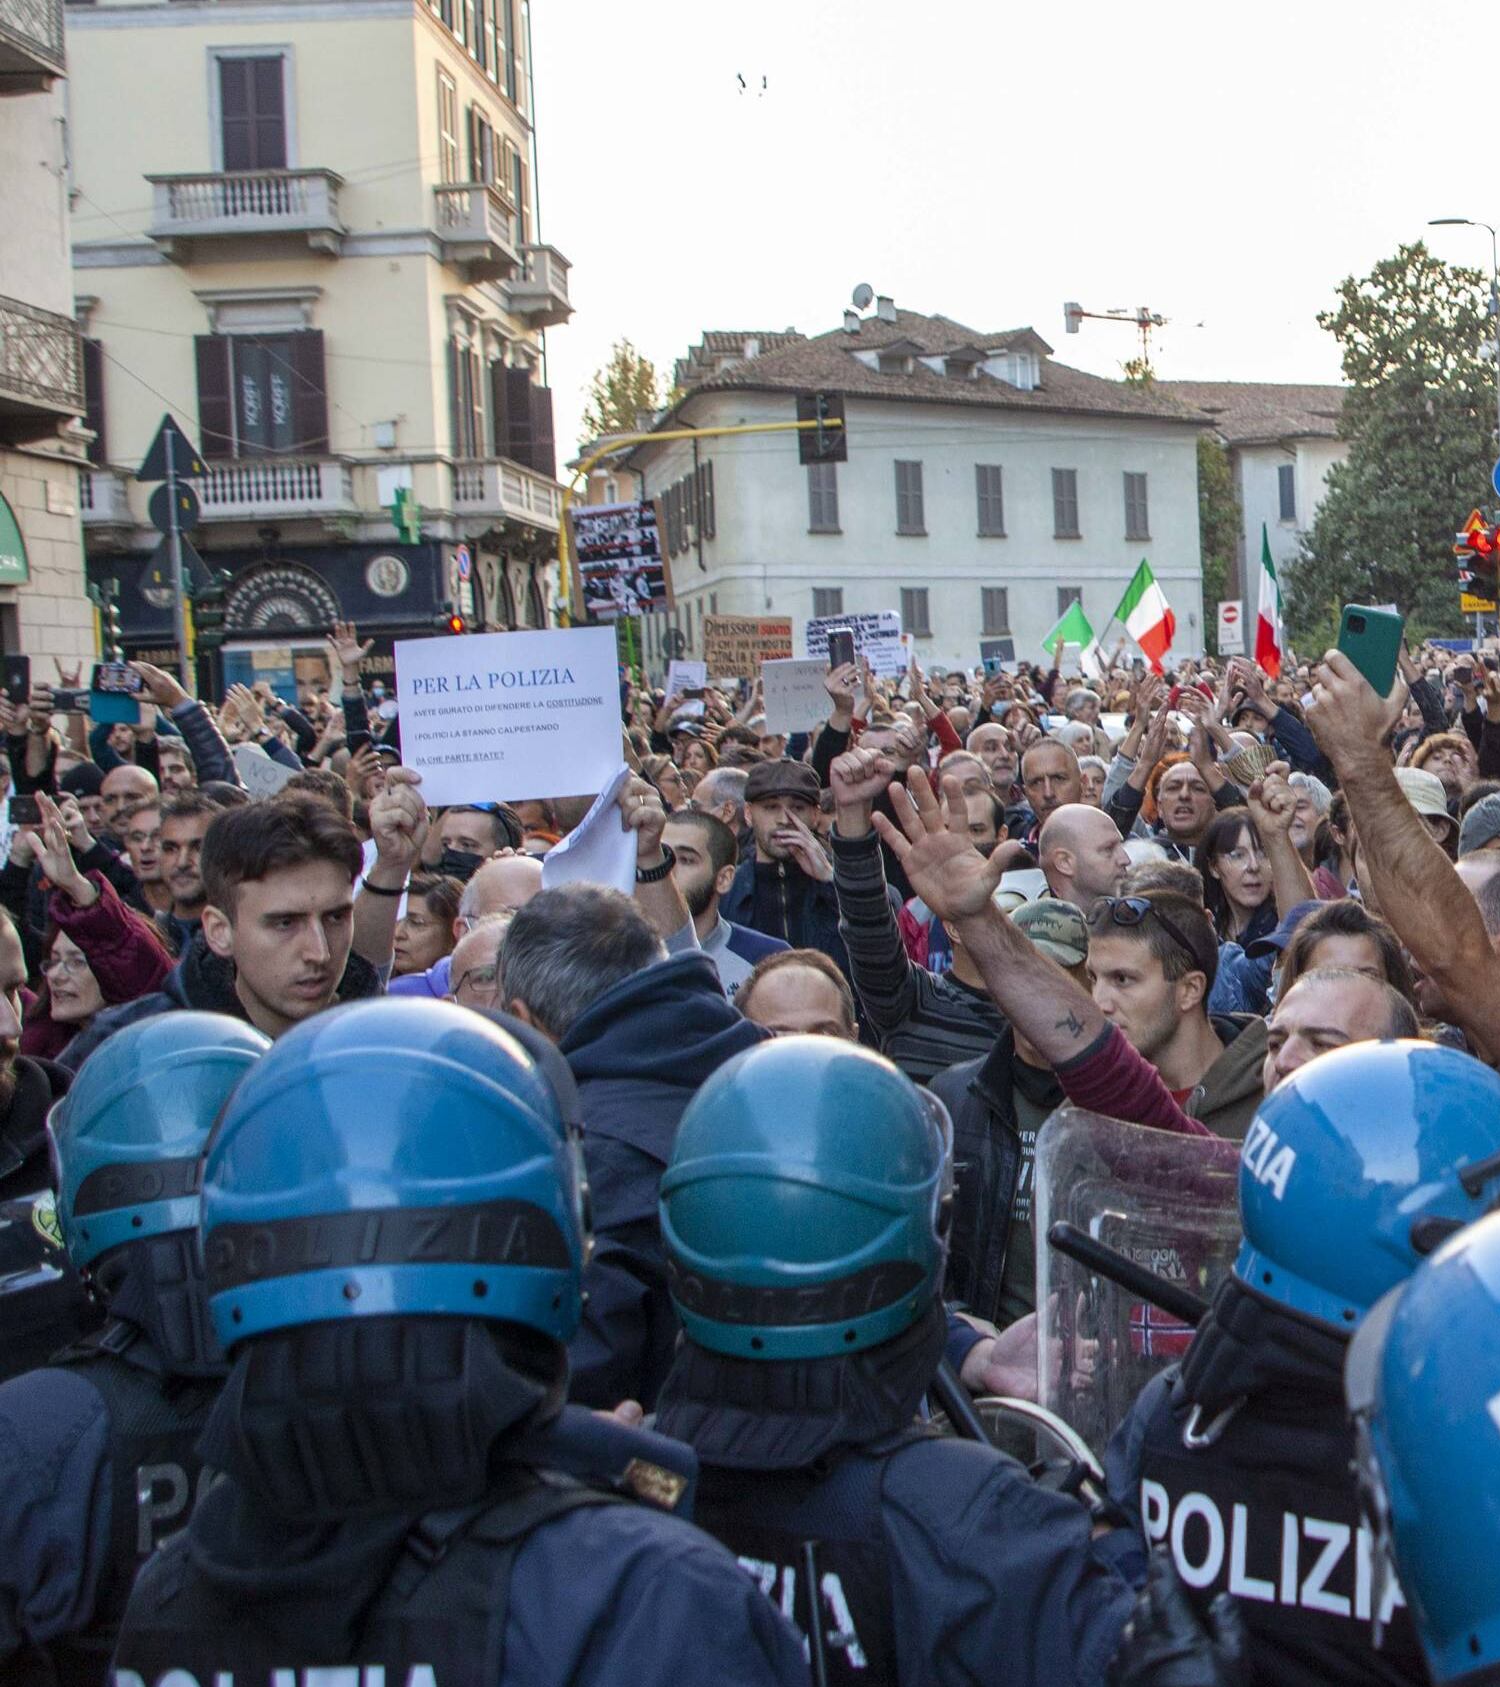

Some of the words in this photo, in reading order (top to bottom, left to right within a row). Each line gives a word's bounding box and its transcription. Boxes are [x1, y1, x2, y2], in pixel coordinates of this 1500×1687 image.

[412, 676, 450, 695] PER
[454, 673, 482, 691] LA
[488, 667, 576, 689] POLIZIA
[413, 708, 437, 717] AVETE
[438, 705, 473, 715] GIURATO
[475, 704, 484, 713] DI
[485, 702, 531, 712] DIFENDERE
[533, 701, 545, 709] LA
[546, 696, 604, 708] COSTITUZIONE
[418, 732, 449, 741] POLITICI
[450, 730, 461, 738] LA
[462, 727, 497, 737] STANNO
[498, 723, 560, 735] CALPESTANDO
[416, 757, 428, 766] DA
[428, 756, 444, 766] CHE
[445, 753, 472, 764] PARTE
[473, 751, 504, 762] STATE?
[215, 1213, 530, 1271] POLIZIA
